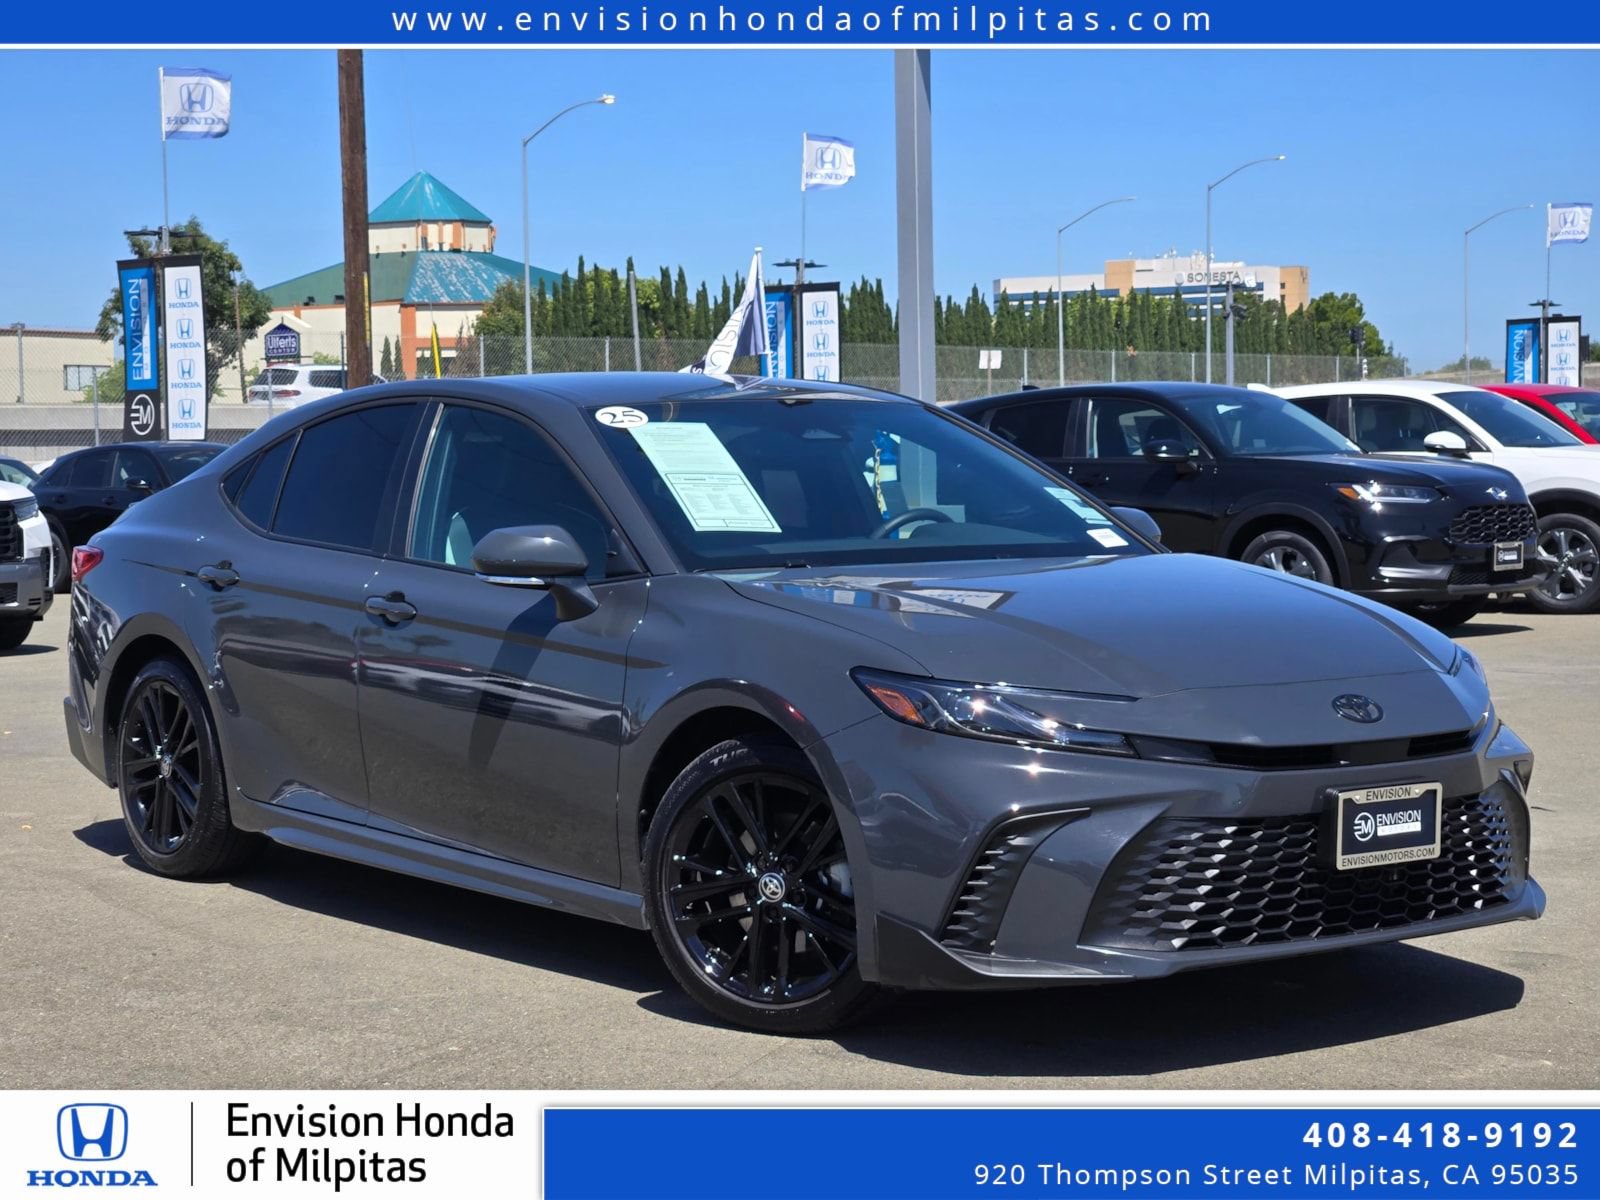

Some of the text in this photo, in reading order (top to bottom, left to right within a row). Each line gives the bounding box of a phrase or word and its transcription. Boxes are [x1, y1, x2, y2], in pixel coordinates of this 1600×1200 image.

[166, 116, 225, 126] HONDA
[1186, 271, 1241, 283] SONESTA
[168, 301, 199, 309] HONDA
[128, 278, 144, 380] ENVISION
[170, 341, 201, 349] HONDA
[600, 410, 643, 424] 25
[1366, 787, 1412, 801] ENVISION
[1376, 809, 1421, 826] ENVISION
[1342, 848, 1435, 867] ENVISIONMOTORS.COM
